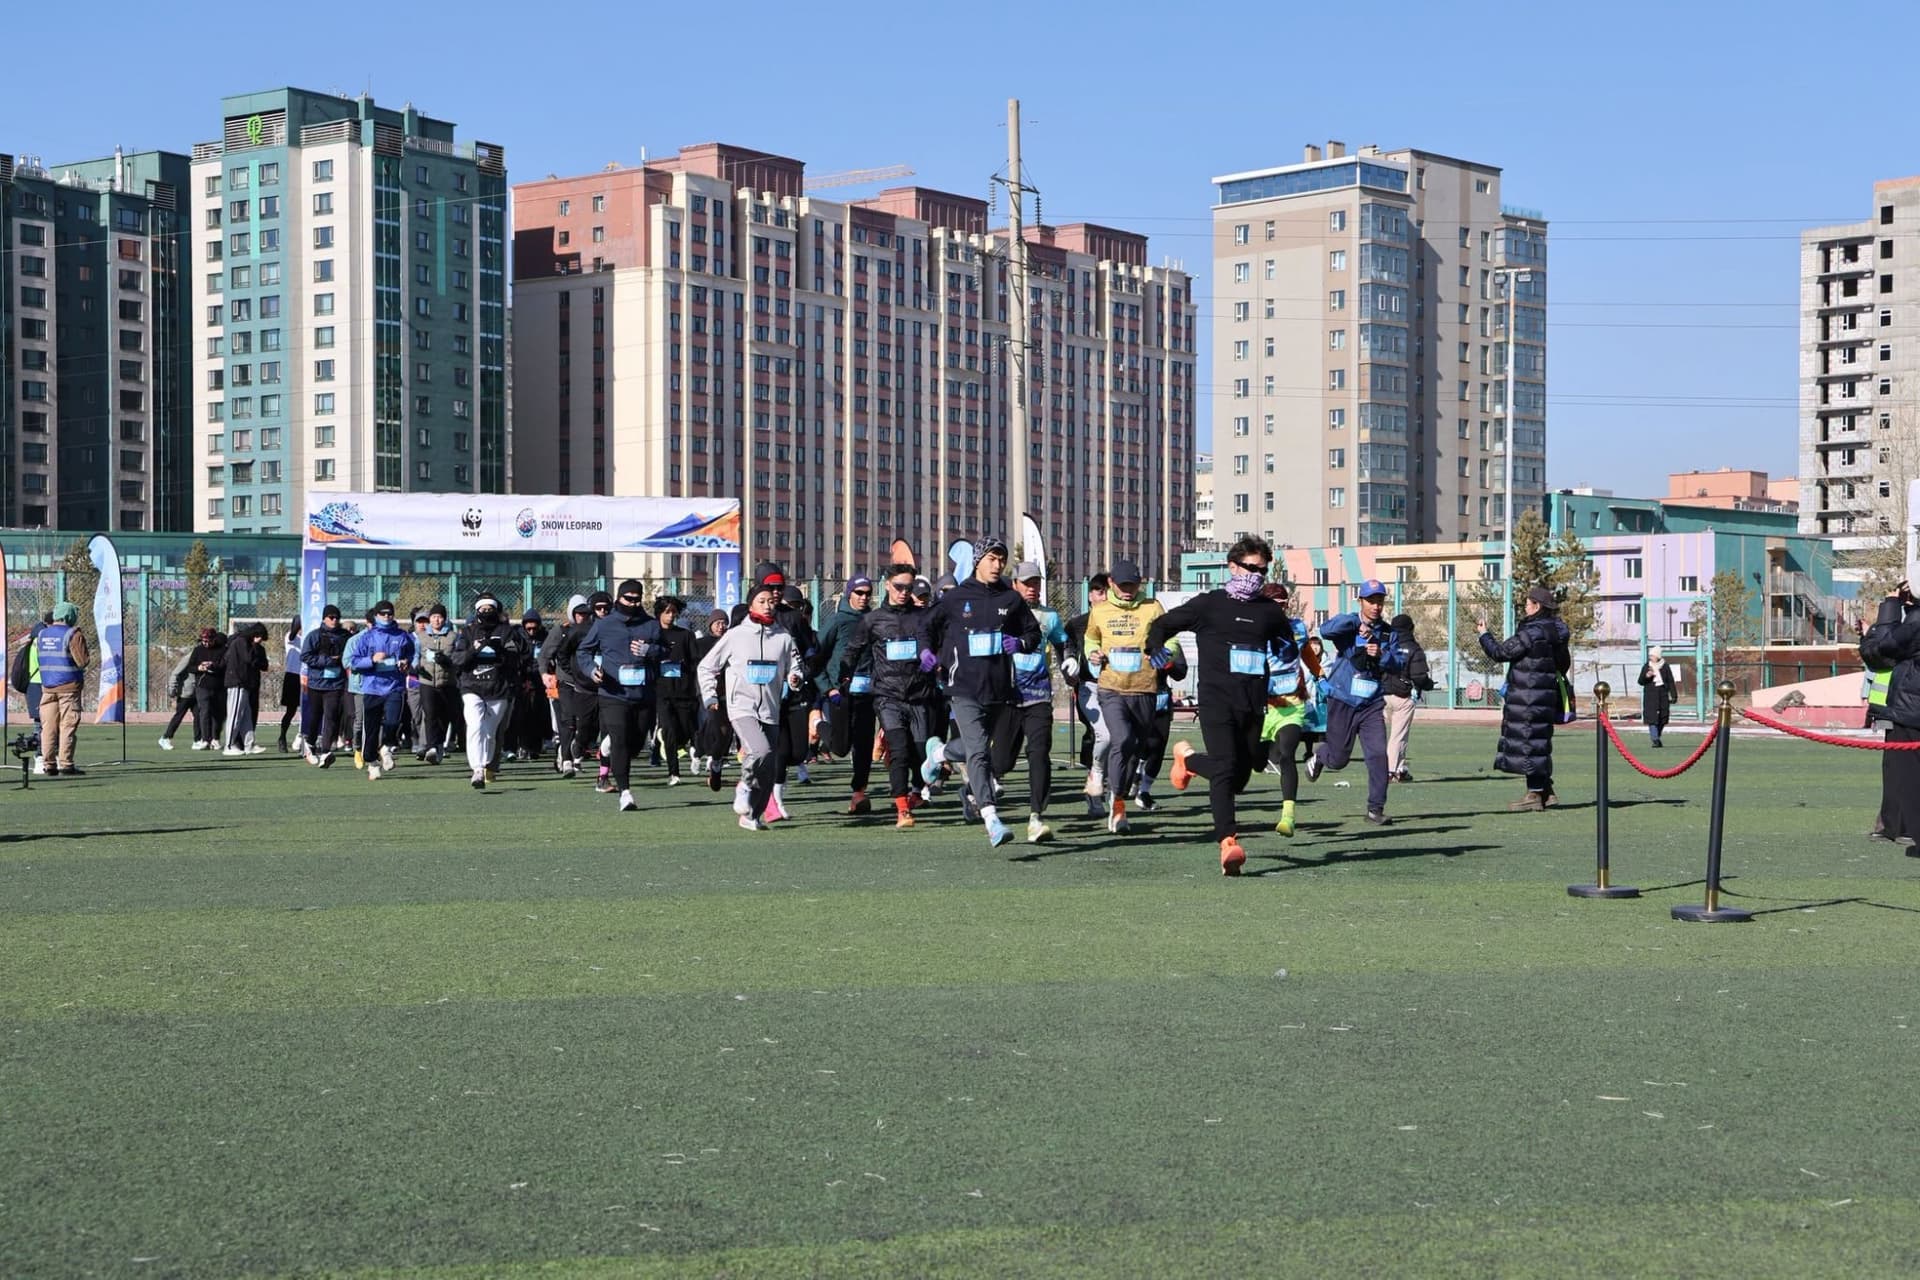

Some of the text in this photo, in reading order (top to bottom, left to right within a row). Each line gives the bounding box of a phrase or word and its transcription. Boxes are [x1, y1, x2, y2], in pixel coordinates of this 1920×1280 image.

[541, 521, 602, 530] SNOW LEOPARD
[726, 570, 736, 605] ГАР
